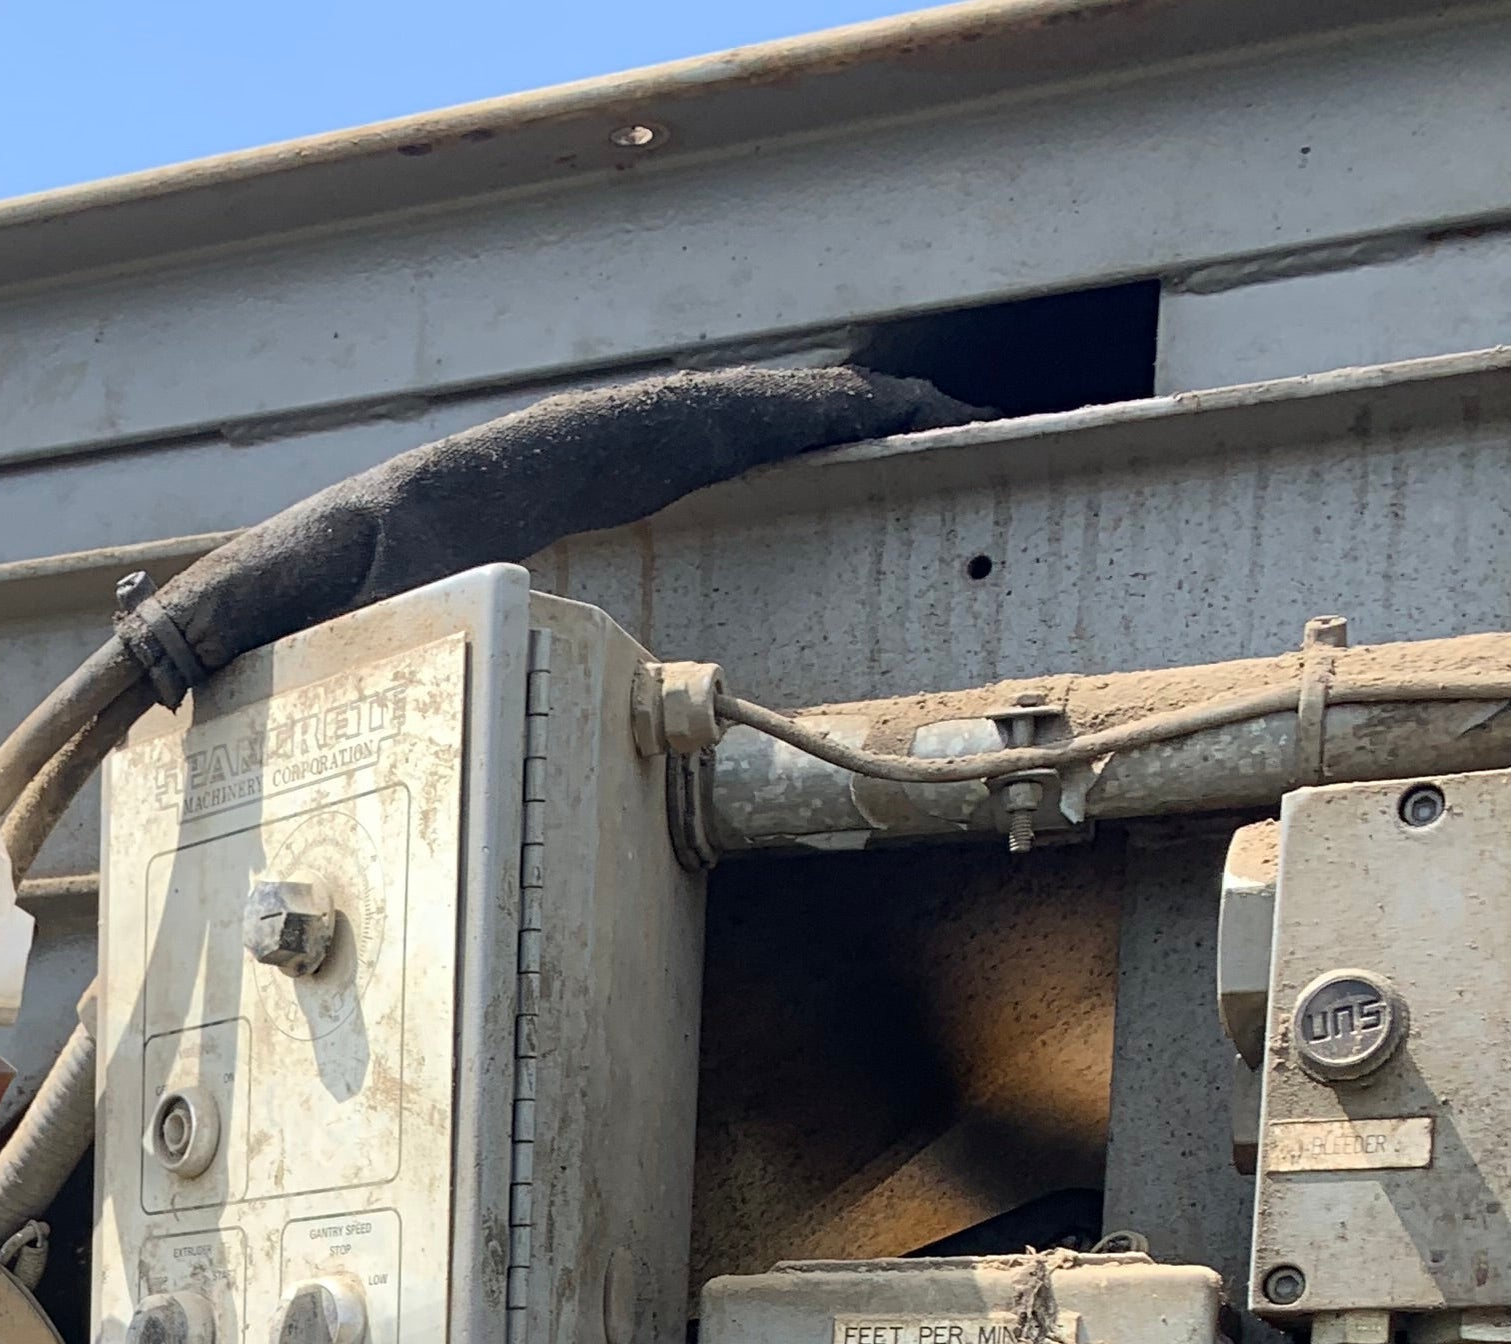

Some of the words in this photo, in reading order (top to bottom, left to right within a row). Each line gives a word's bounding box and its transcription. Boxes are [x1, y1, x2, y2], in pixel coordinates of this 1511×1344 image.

[184, 776, 264, 814] MACHINERY
[273, 739, 373, 787] CORPORATION
[1312, 1134, 1387, 1155] BLEEDER
[309, 1226, 344, 1240] GANTRY
[345, 1222, 372, 1236] SPEED
[329, 1244, 352, 1257] STOP
[368, 1274, 389, 1286] LOW
